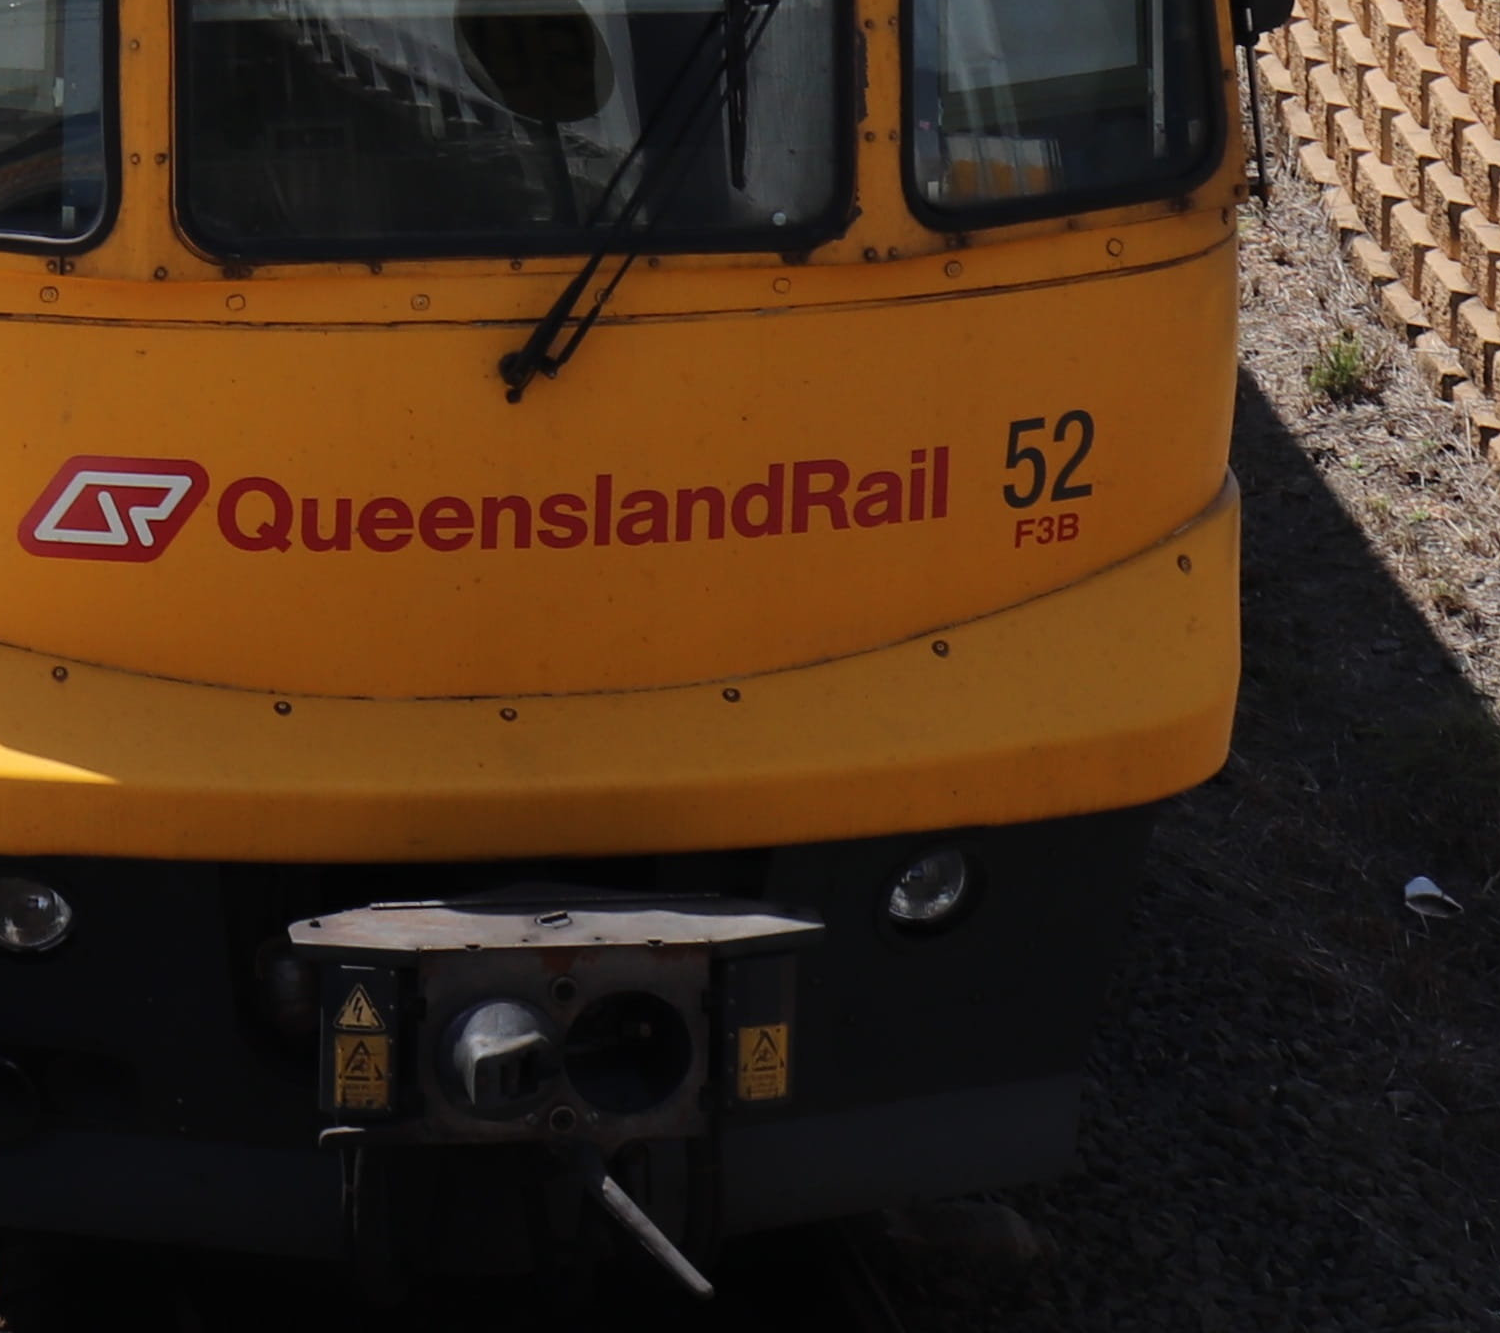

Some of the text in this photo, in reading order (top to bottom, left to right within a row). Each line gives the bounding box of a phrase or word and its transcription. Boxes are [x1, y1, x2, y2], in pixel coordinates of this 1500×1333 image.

[216, 446, 950, 555] QueenslandRail
[1003, 409, 1095, 510] 52
[1014, 512, 1080, 550] F3B
